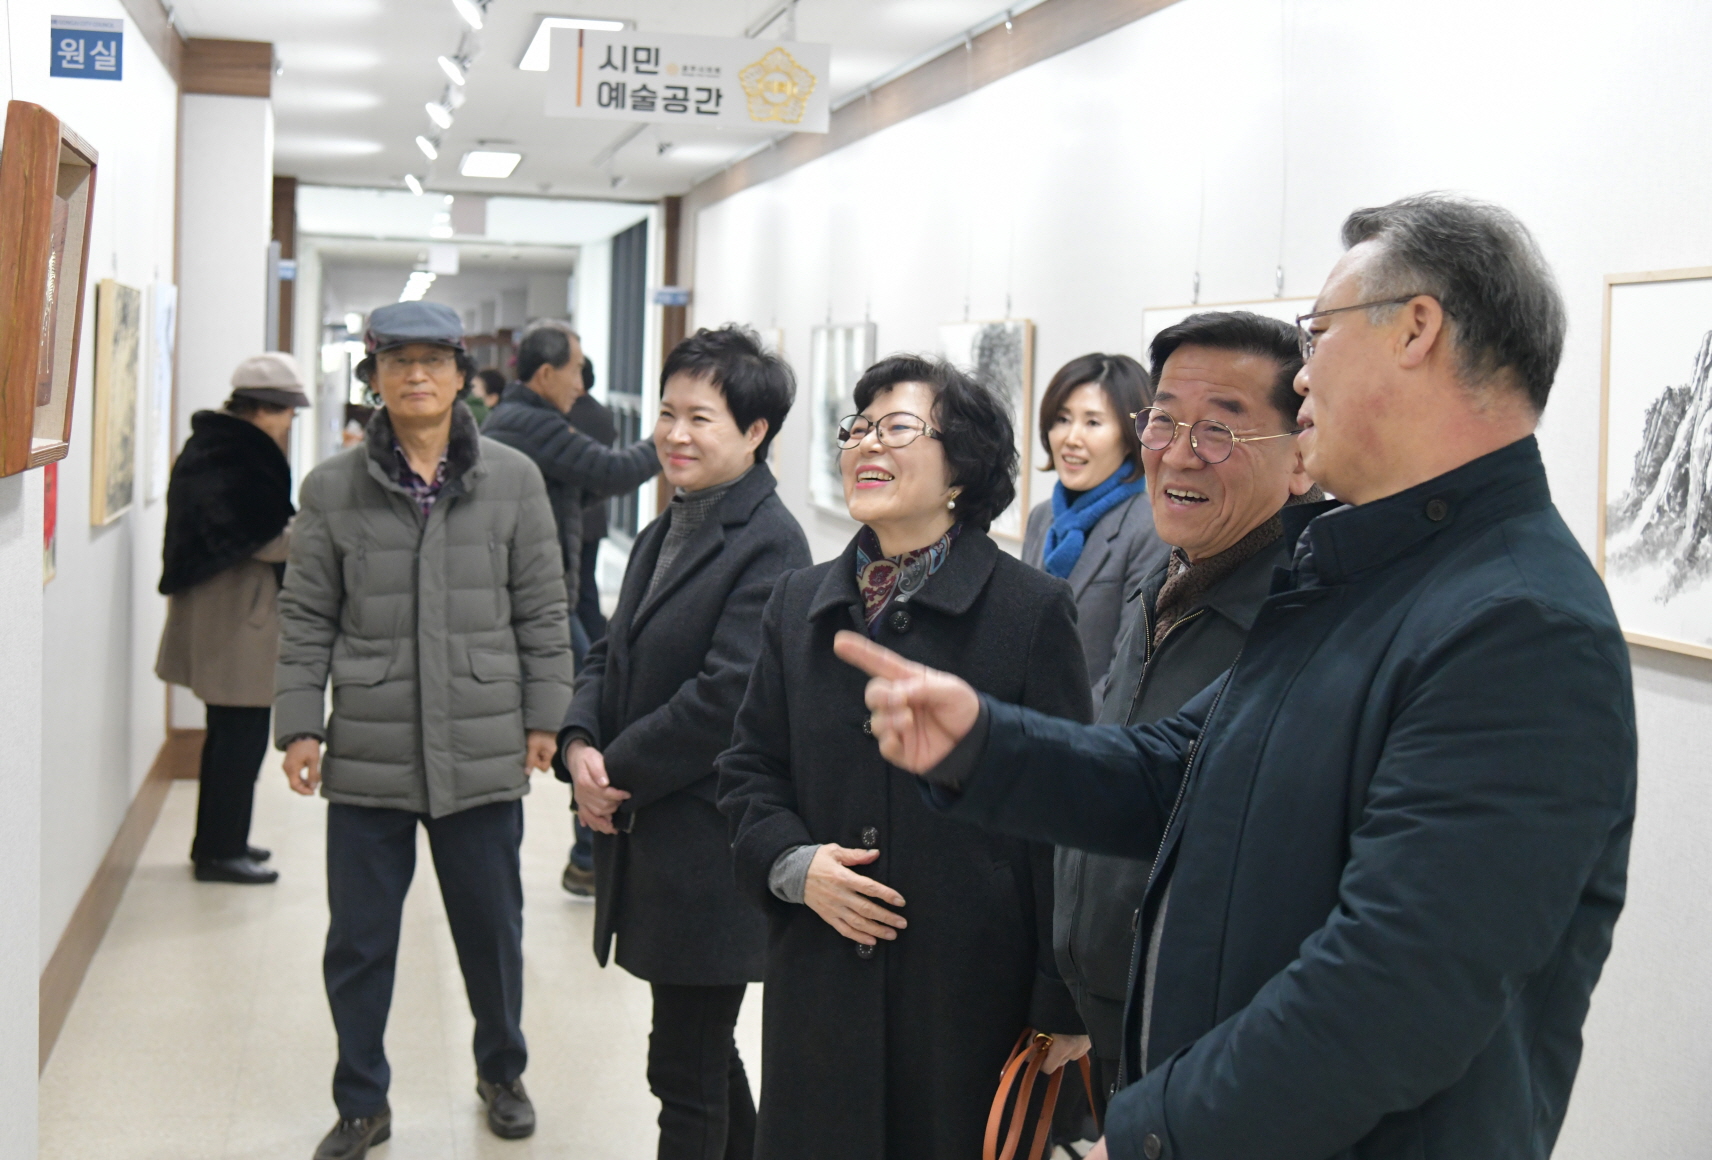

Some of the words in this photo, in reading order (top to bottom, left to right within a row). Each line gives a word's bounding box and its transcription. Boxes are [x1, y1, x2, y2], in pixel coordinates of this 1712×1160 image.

[57, 38, 117, 71] 원실
[598, 45, 660, 75] 시민
[597, 81, 723, 116] 예술공간
